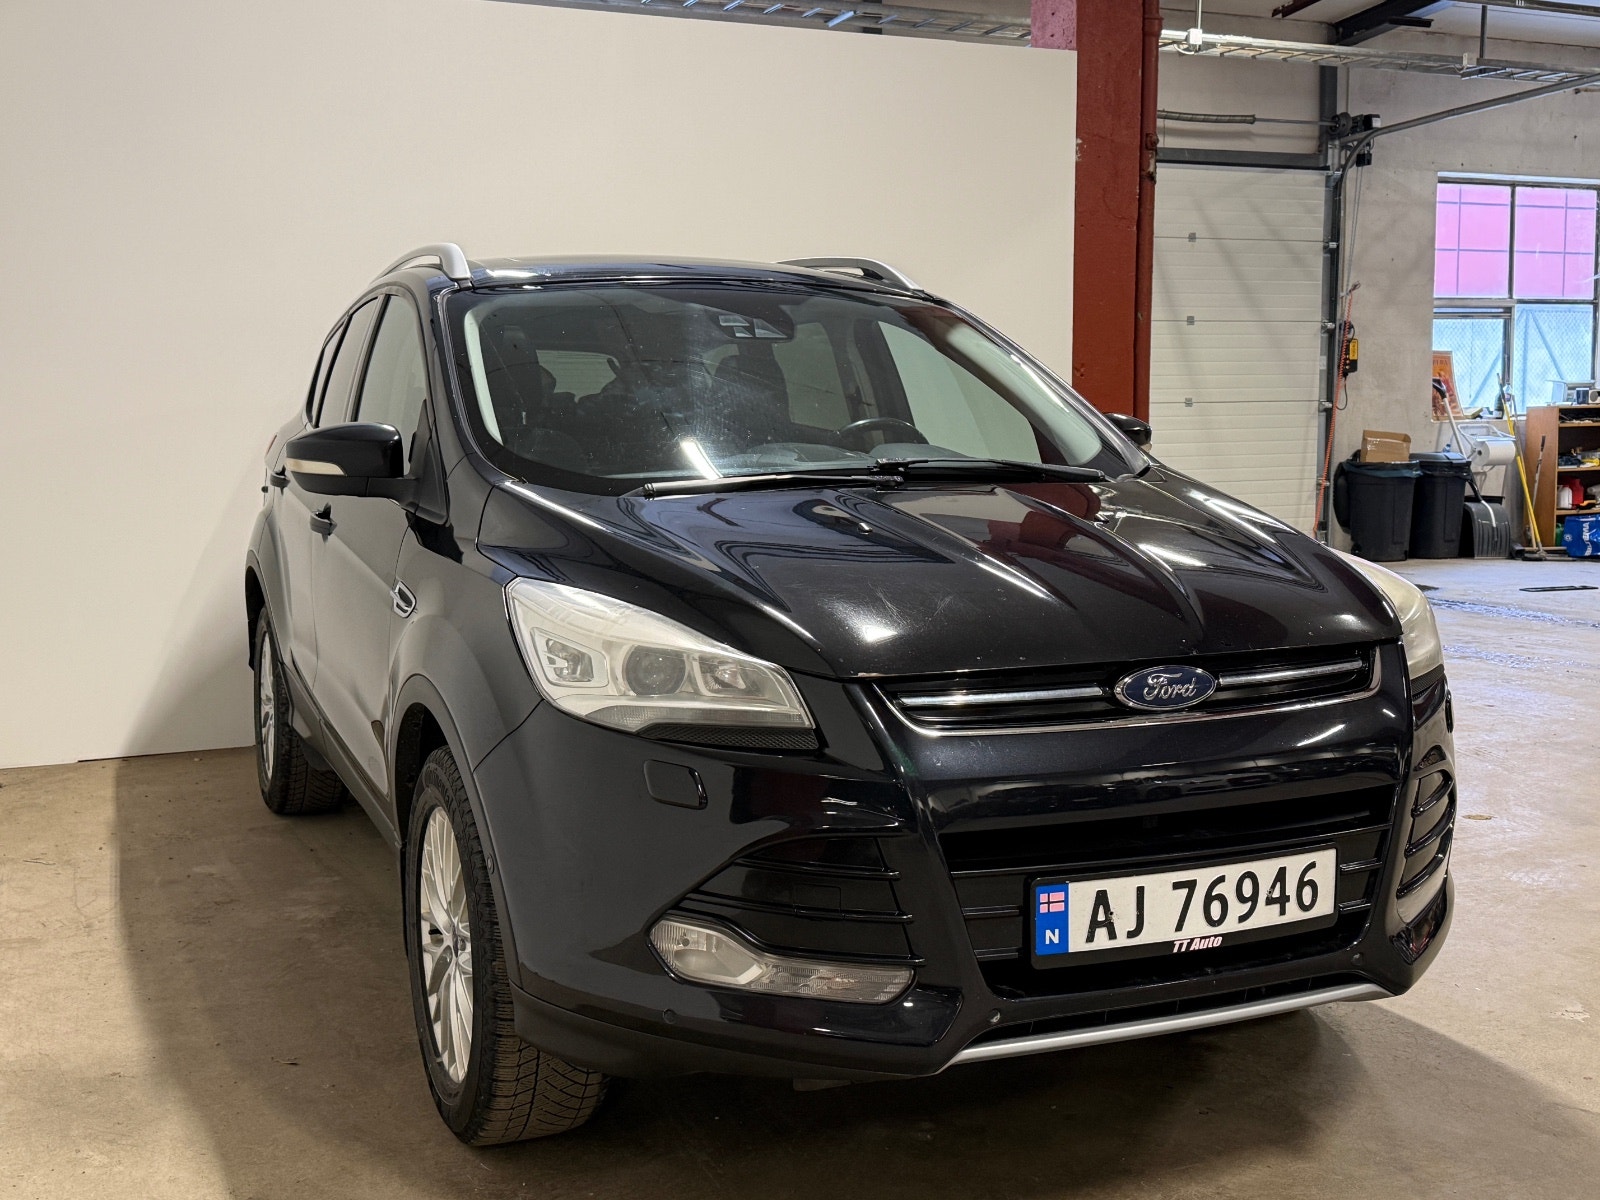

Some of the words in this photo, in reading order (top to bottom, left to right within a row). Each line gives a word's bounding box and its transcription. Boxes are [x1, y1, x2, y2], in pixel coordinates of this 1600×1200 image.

[1143, 673, 1196, 700] Ford
[1086, 886, 1145, 943] AJ
[1172, 860, 1318, 932] 76946
[1045, 929, 1059, 944] N
[1172, 939, 1190, 953] TT
[1190, 936, 1222, 951] Auto
